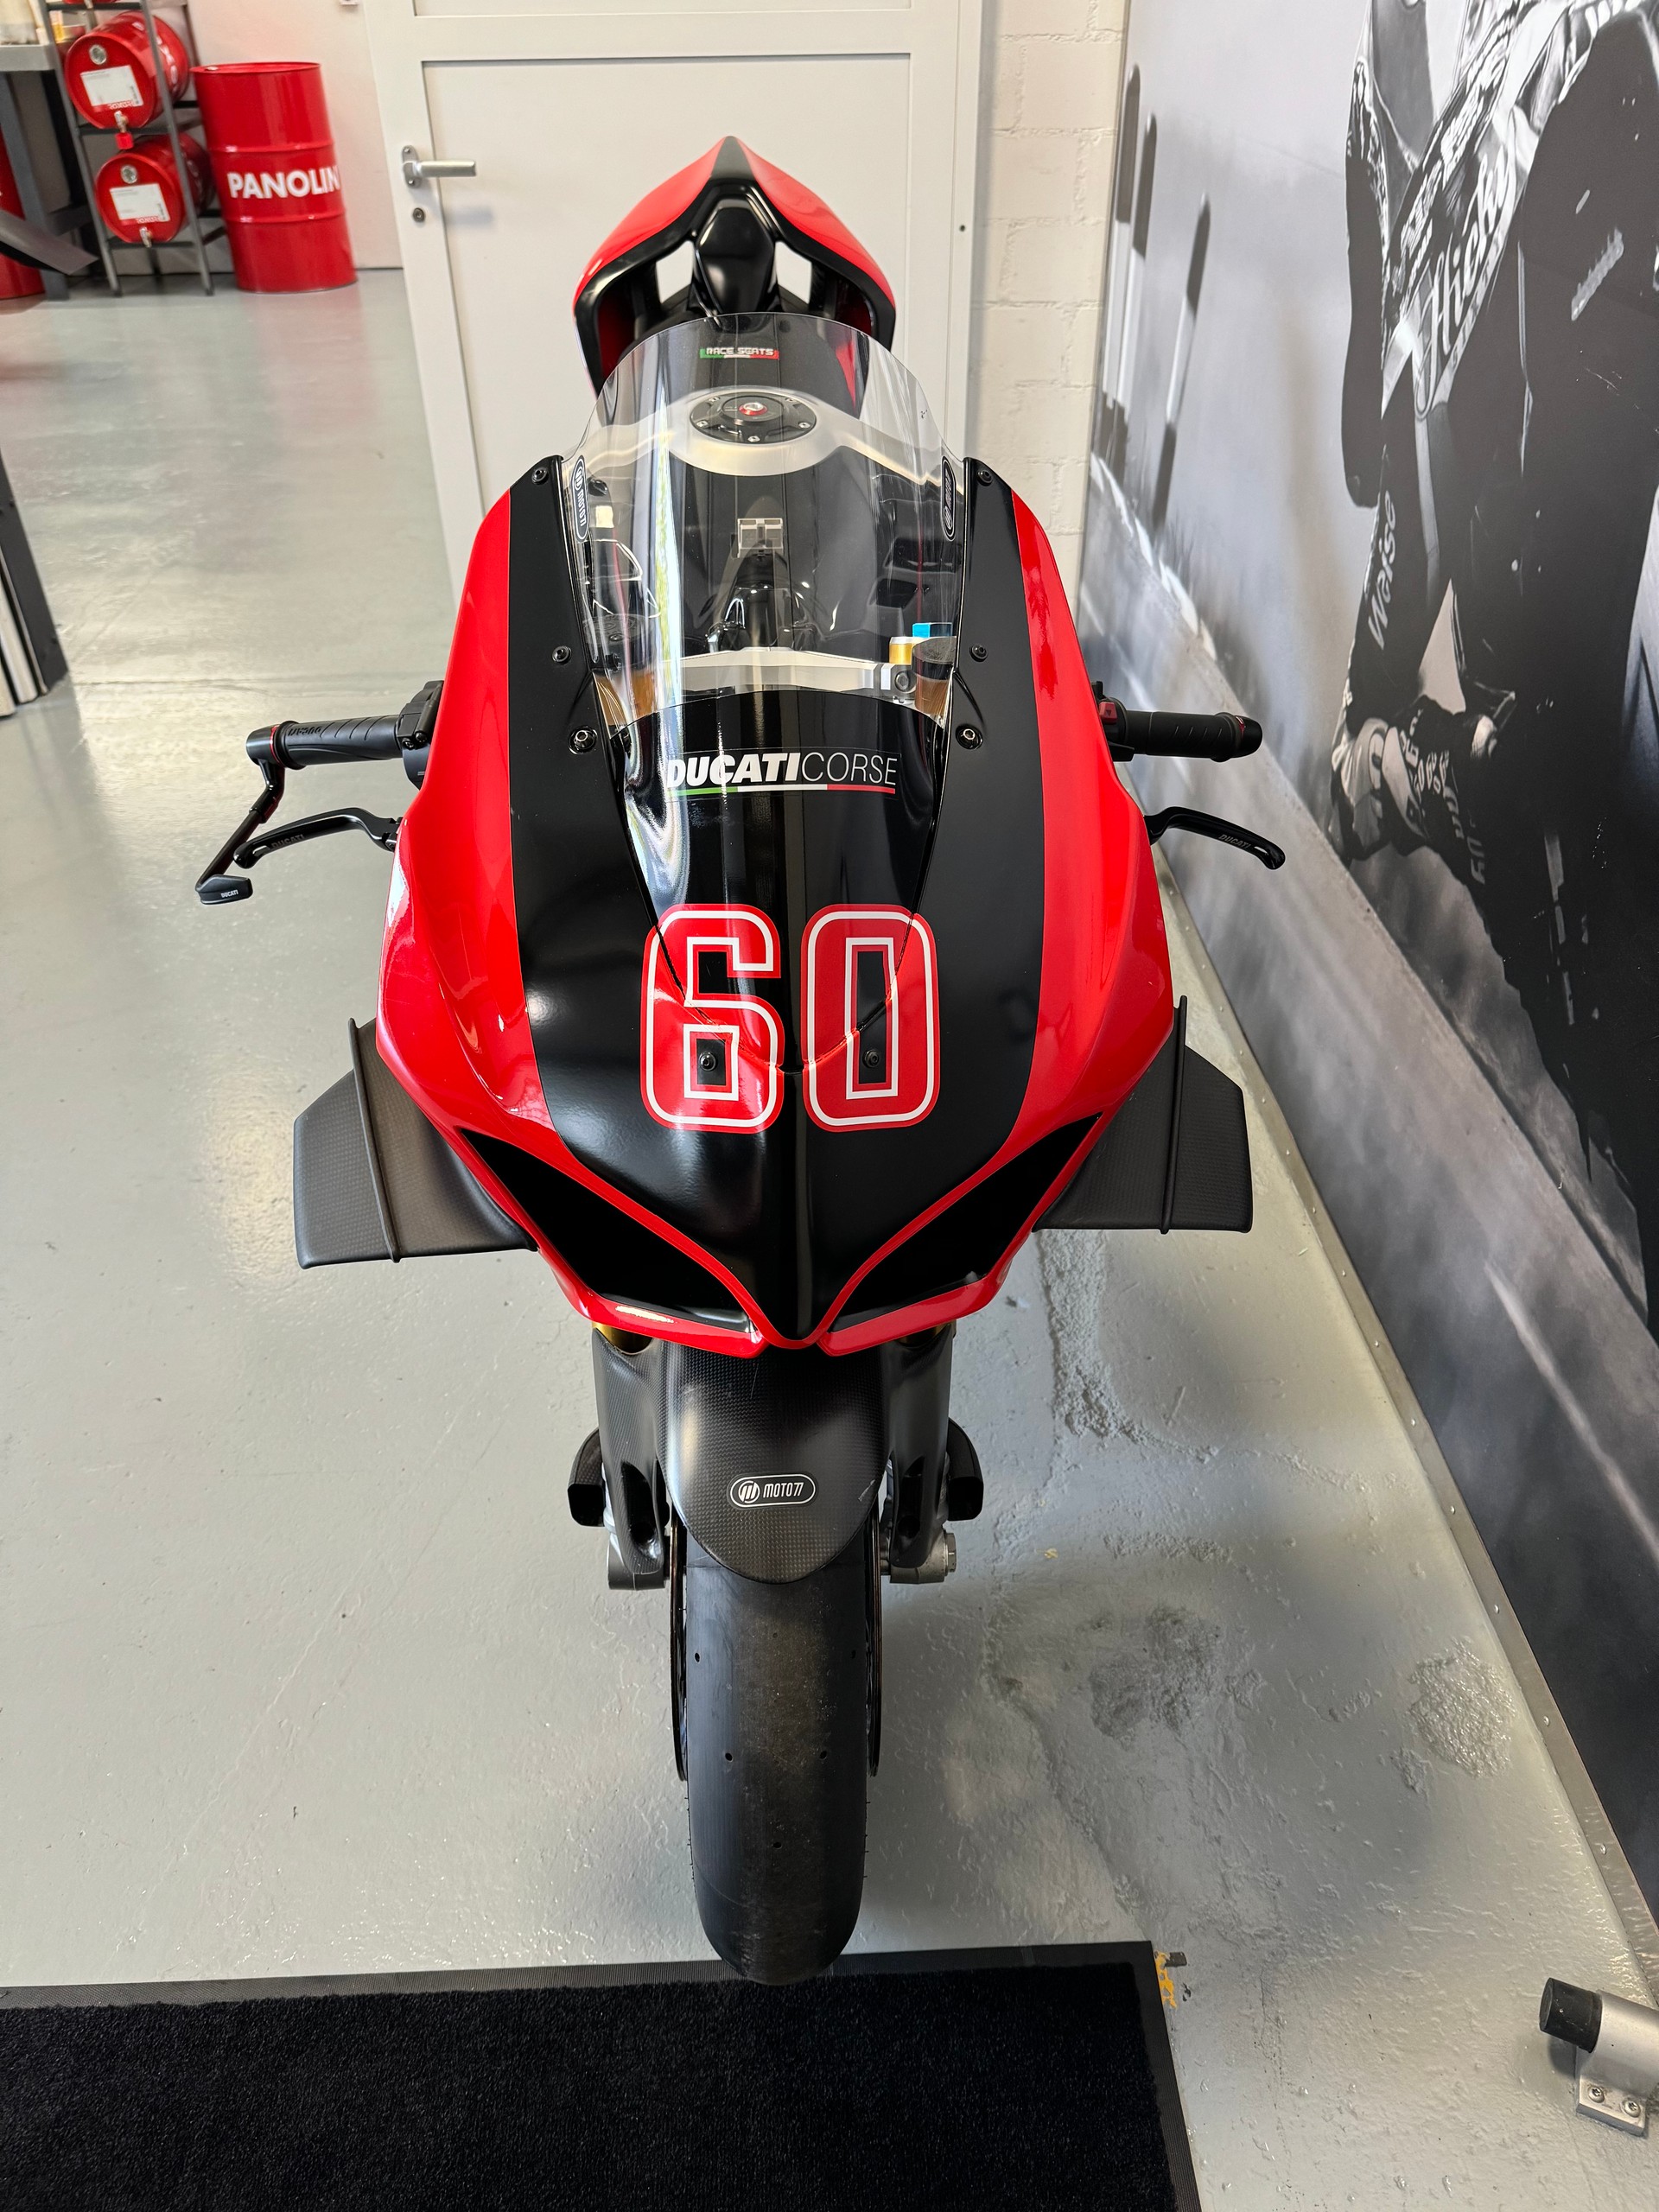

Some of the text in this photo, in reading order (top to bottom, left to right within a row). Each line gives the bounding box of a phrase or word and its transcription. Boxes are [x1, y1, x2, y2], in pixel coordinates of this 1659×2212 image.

[227, 165, 340, 199] PANOLIN
[737, 347, 774, 356] SEATS
[1368, 490, 1396, 650] Weise
[270, 834, 305, 850] DUCATI
[1218, 834, 1252, 849] DUCATI
[220, 889, 239, 898] DUCATI
[640, 903, 941, 1135] 60
